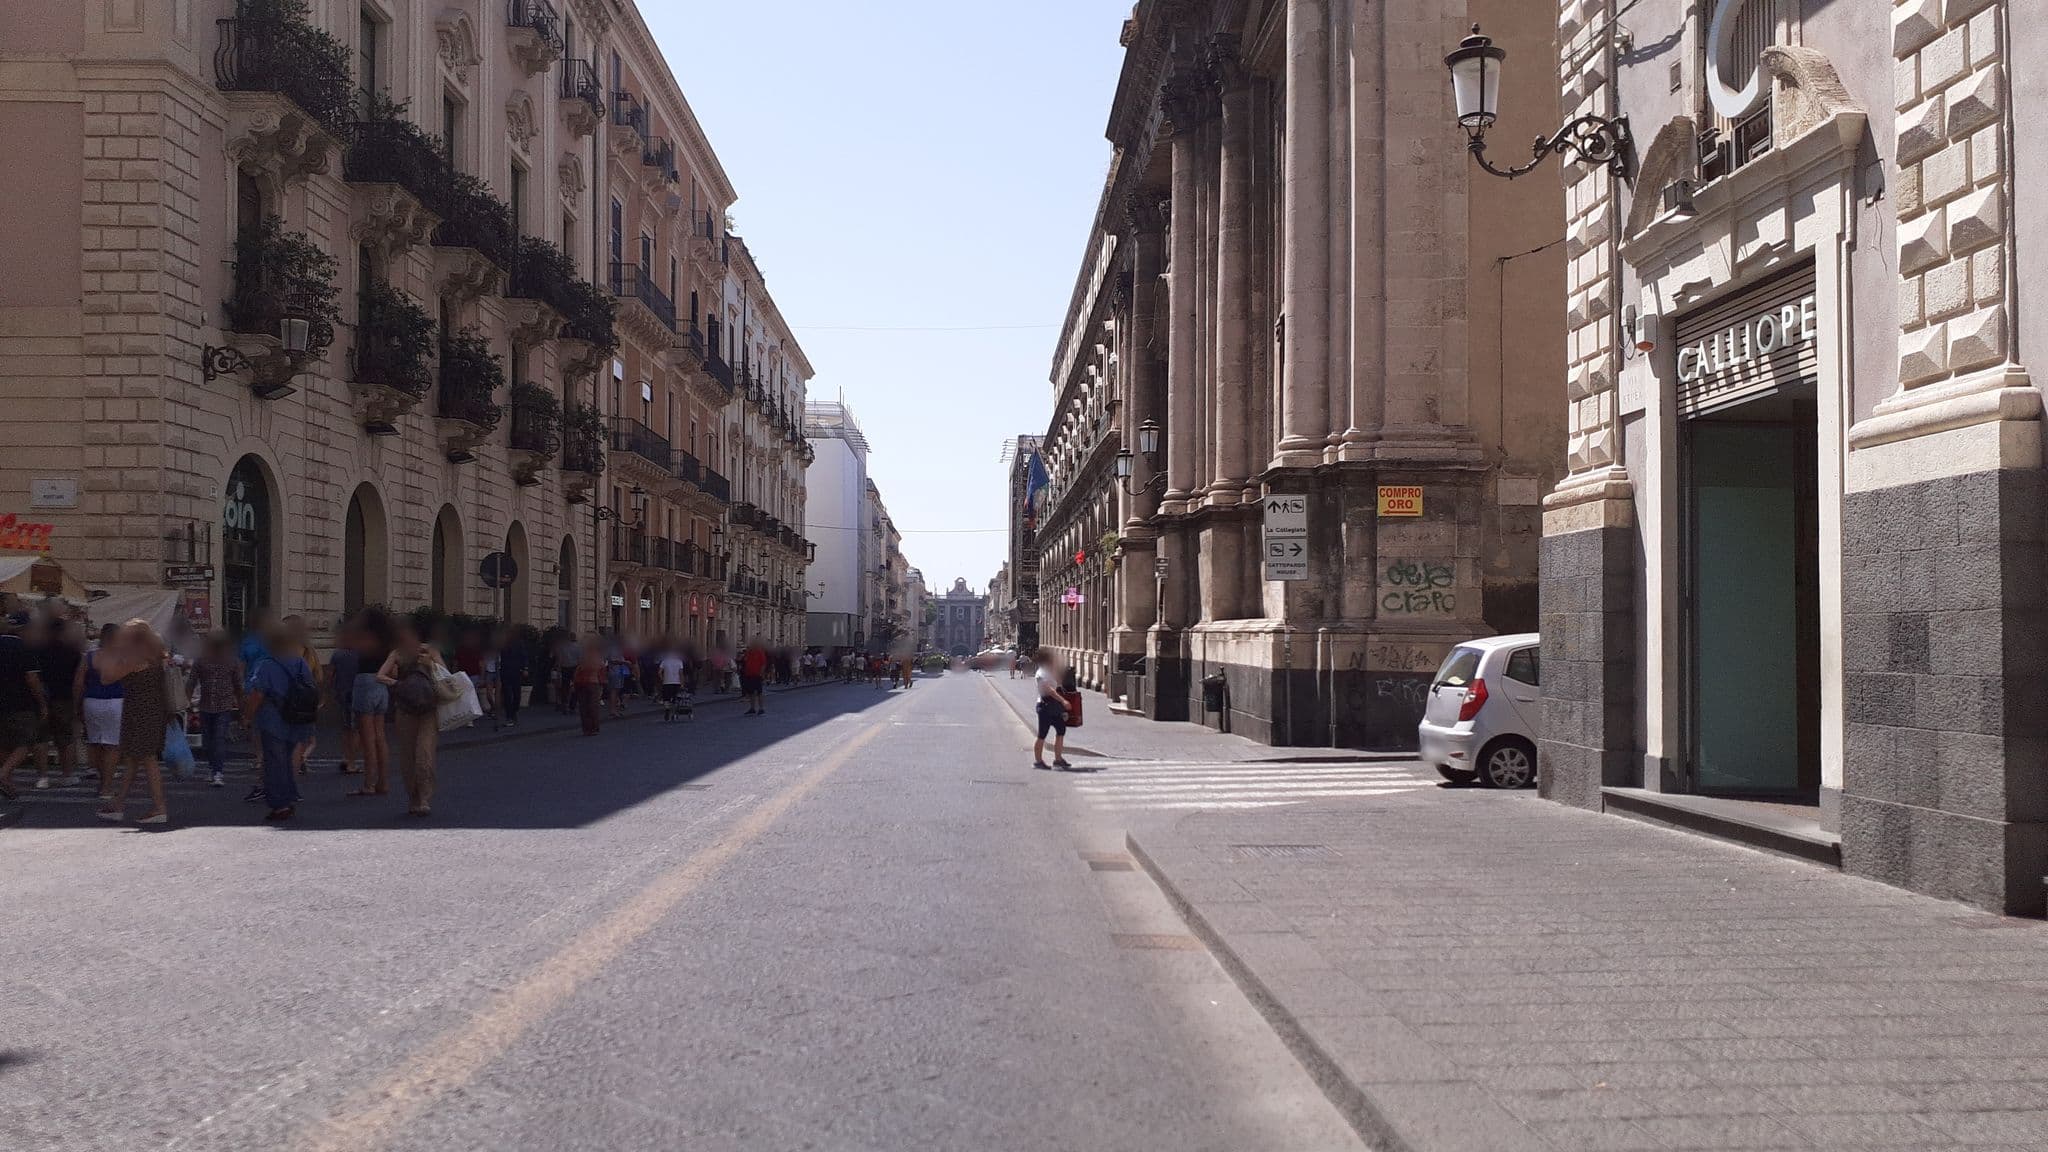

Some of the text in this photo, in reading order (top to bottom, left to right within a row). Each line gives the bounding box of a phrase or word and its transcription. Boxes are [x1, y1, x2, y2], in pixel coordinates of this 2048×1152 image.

[1677, 295, 1817, 382] CALLIOPE
[224, 481, 255, 530] oin
[1379, 488, 1421, 498] COMPRO
[1387, 499, 1414, 509] ORO
